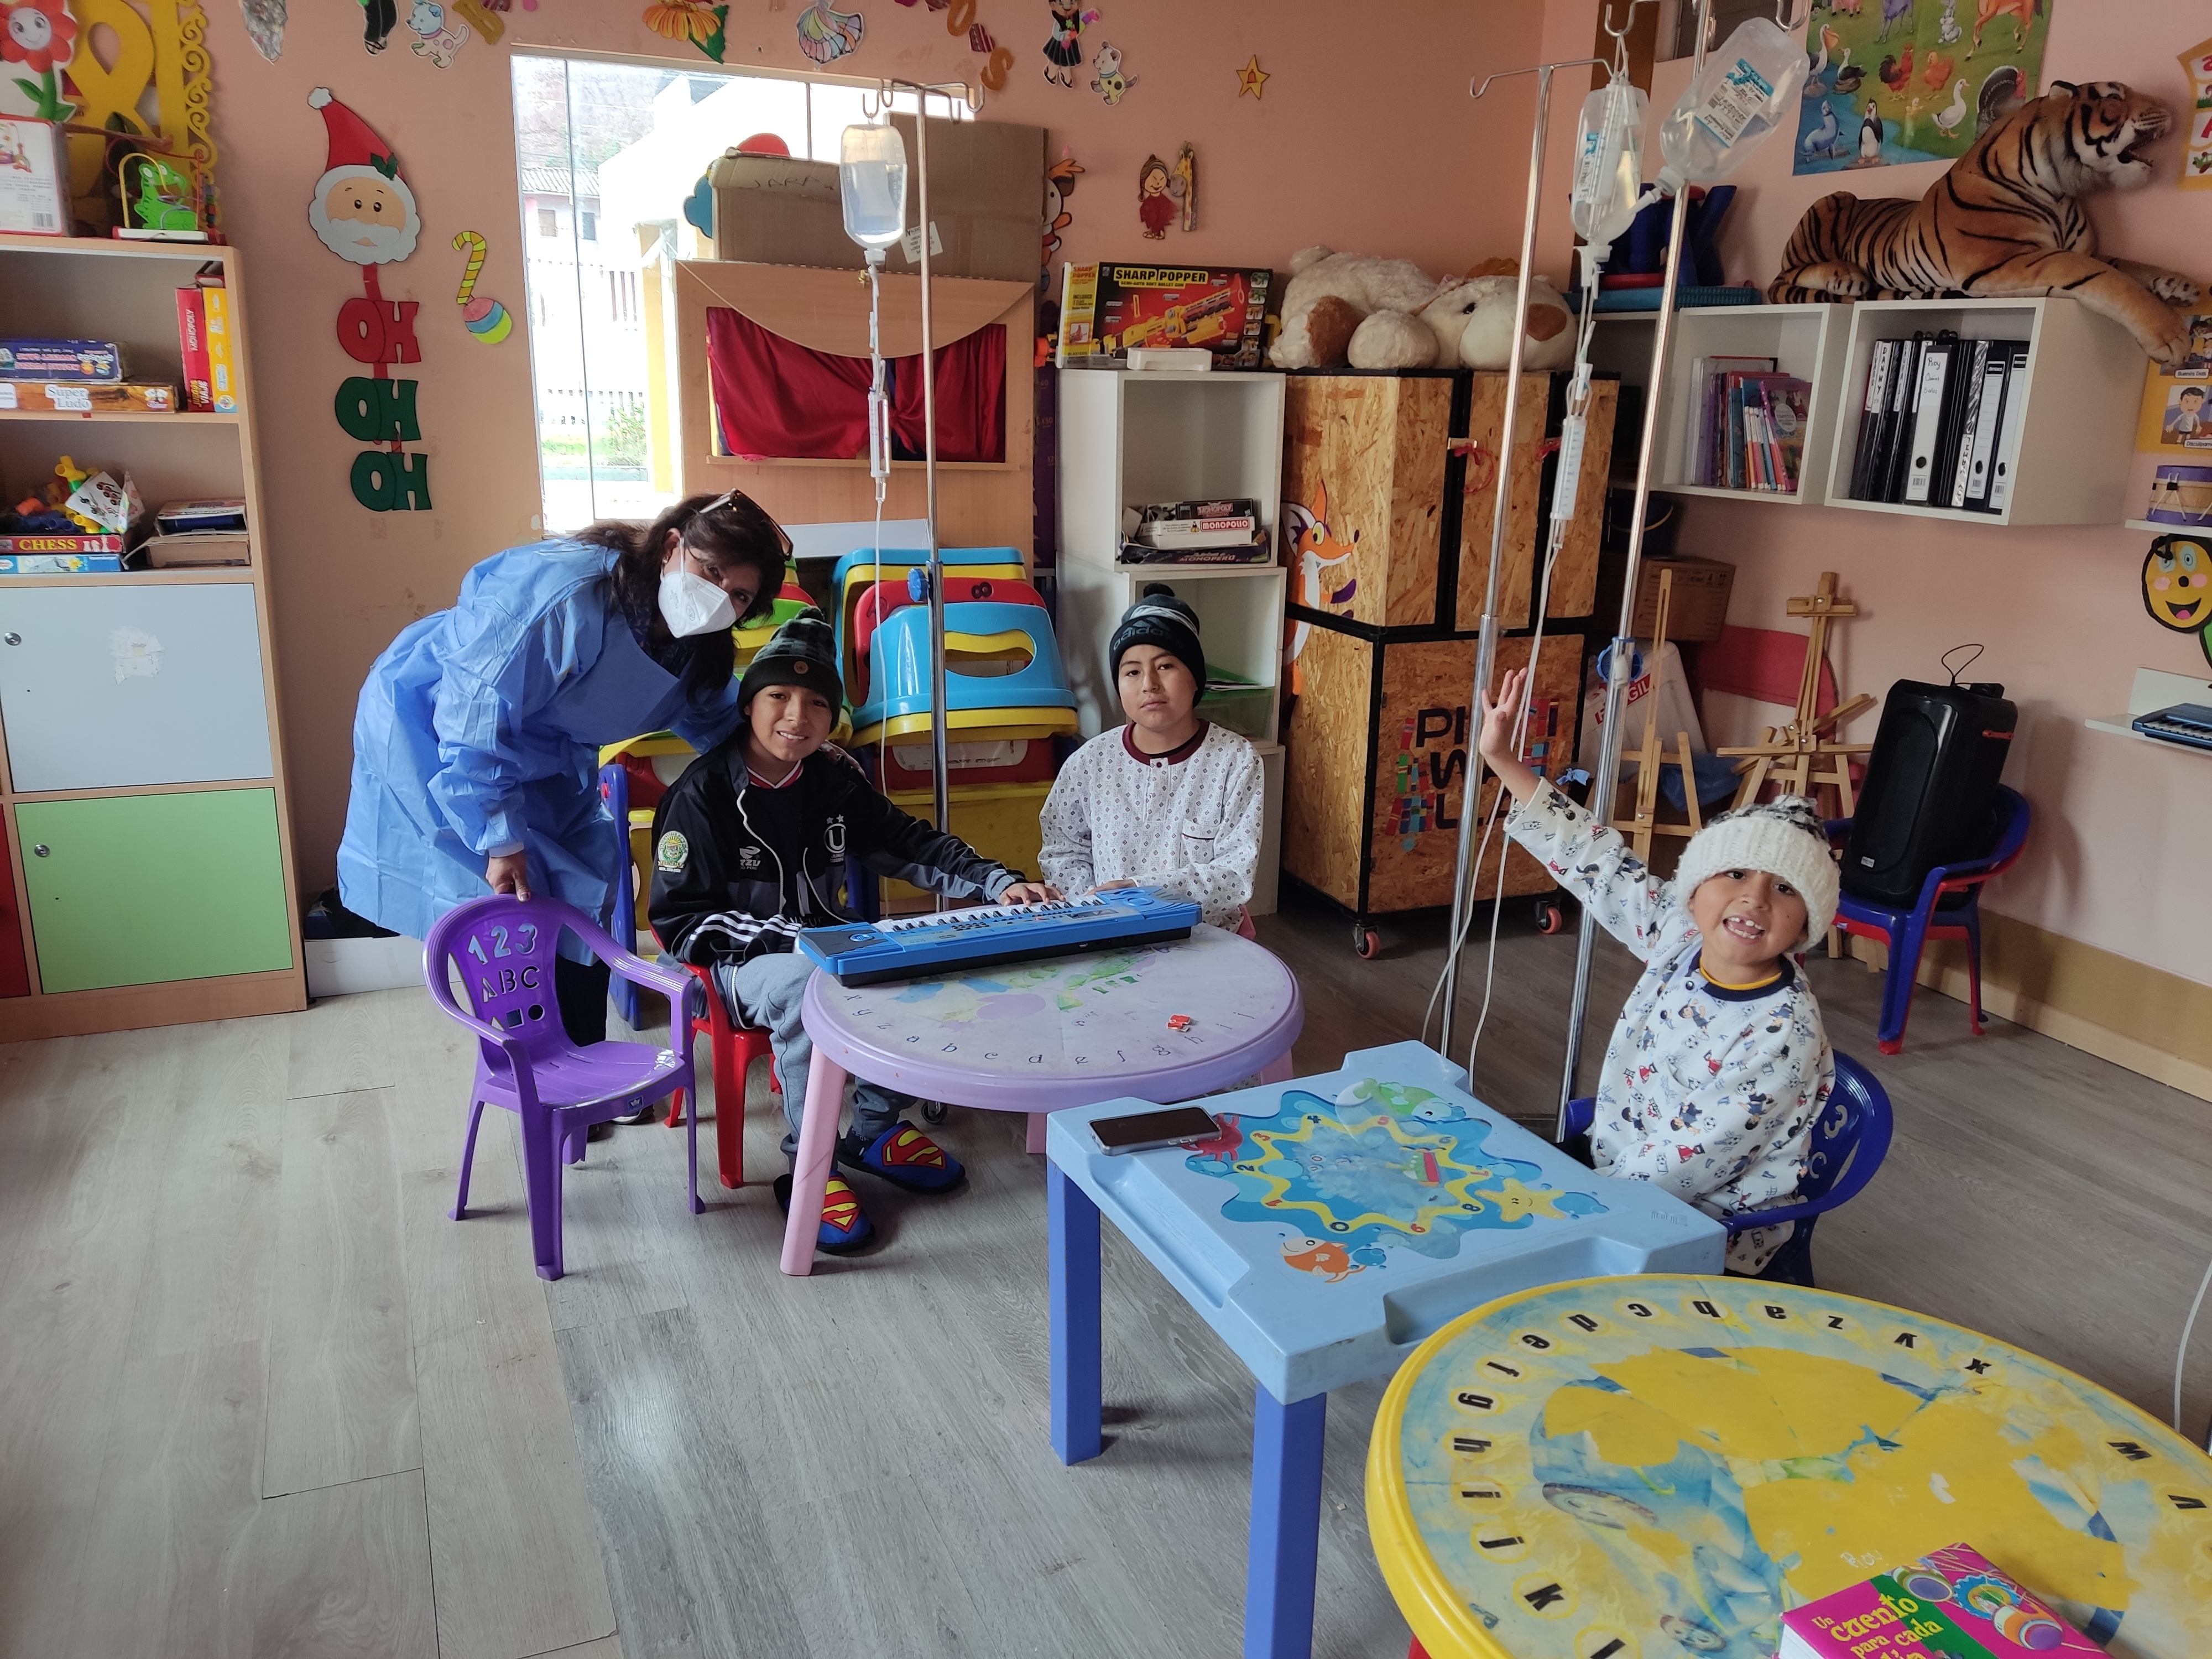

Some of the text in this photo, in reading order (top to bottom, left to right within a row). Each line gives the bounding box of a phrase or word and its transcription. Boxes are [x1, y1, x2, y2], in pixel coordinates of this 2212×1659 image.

[1115, 269, 1206, 283] SHARP POPPER
[1877, 347, 1887, 395] DANNY
[1927, 357, 1941, 370] Roy
[48, 386, 87, 398] Super
[58, 398, 90, 408] Ludo
[1202, 520, 1249, 530] MONOPOLIO
[19, 538, 77, 550] CHESS
[1595, 679, 1649, 724] FGIL
[468, 922, 538, 965] 123
[483, 966, 540, 1003] ABC
[906, 1035, 920, 1044] a
[941, 1043, 958, 1053] b
[1029, 1054, 1042, 1064] d
[1074, 1056, 1088, 1065] e
[1117, 1050, 1126, 1062] f
[1152, 1045, 1171, 1056] g
[1185, 1036, 1204, 1044] h
[1377, 1116, 1389, 1125] 5
[1253, 1132, 1271, 1141] 3
[1237, 1164, 1255, 1172] 2
[1265, 1199, 1283, 1207] 1
[1462, 1203, 1481, 1212] 8
[1330, 1222, 1349, 1232] 0
[1627, 1302, 1652, 1318] c
[1692, 1300, 1721, 1318] b
[1764, 1304, 1787, 1321] a
[1567, 1314, 1599, 1333] d
[1521, 1333, 1551, 1350] e
[1486, 1360, 1520, 1378] f
[1964, 1357, 1992, 1375] x
[1457, 1392, 1494, 1410] g
[1453, 1437, 1492, 1453] h
[1461, 1490, 1502, 1499] i
[1478, 1535, 1525, 1549] j
[1524, 1582, 1565, 1612] k
[1811, 1615, 1835, 1629] Un
[1830, 1593, 1919, 1642] cuento
[1850, 1617, 1944, 1659] para cada
